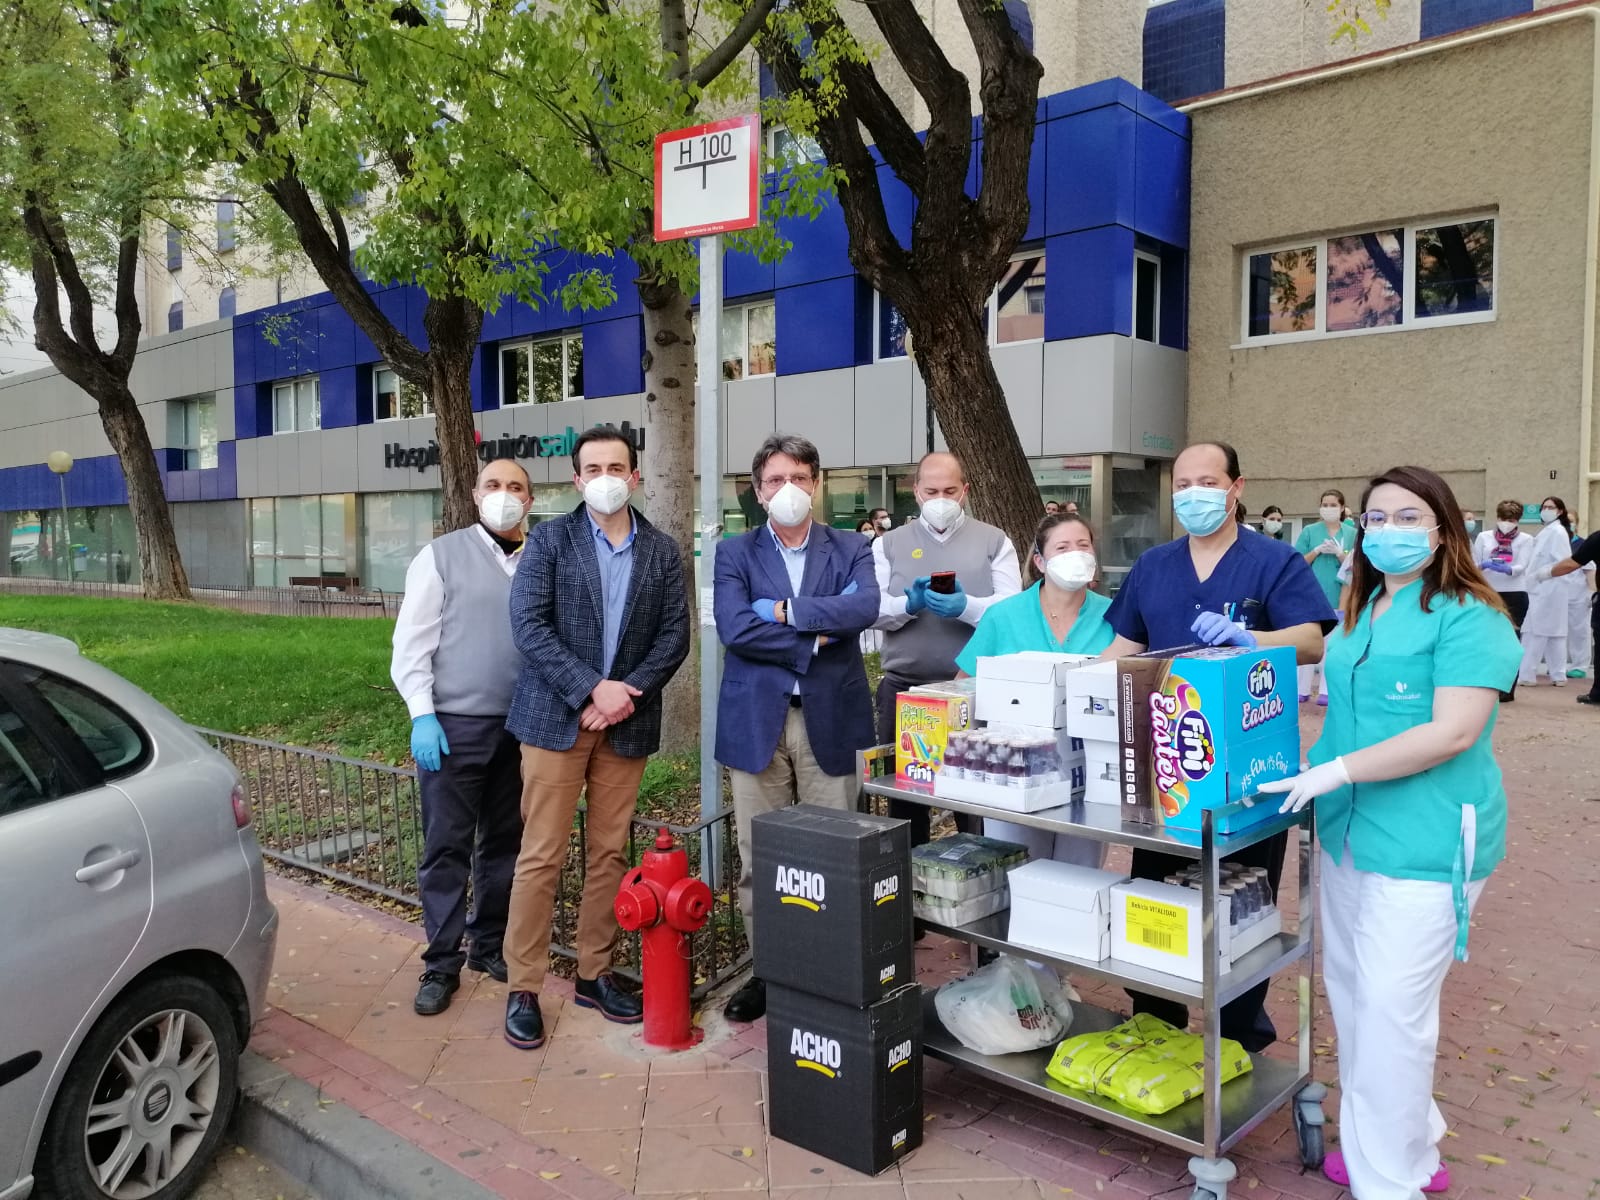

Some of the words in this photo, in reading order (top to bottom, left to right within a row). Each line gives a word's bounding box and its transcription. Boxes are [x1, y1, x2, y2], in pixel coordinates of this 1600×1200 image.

[680, 140, 692, 164] H
[700, 132, 732, 160] 100
[1249, 661, 1274, 694] Fini
[1241, 693, 1284, 732] Easter
[1150, 692, 1182, 793] Easter
[1180, 717, 1211, 771] Fini
[907, 764, 932, 782] Fini
[776, 865, 825, 901] ACHO
[873, 874, 899, 902] ACHO
[1149, 904, 1177, 918] VITALIDAD
[880, 964, 896, 980] ACHO
[790, 1028, 842, 1069] ACHO
[887, 1039, 912, 1068] ACHO
[892, 1128, 907, 1148] ACHO
